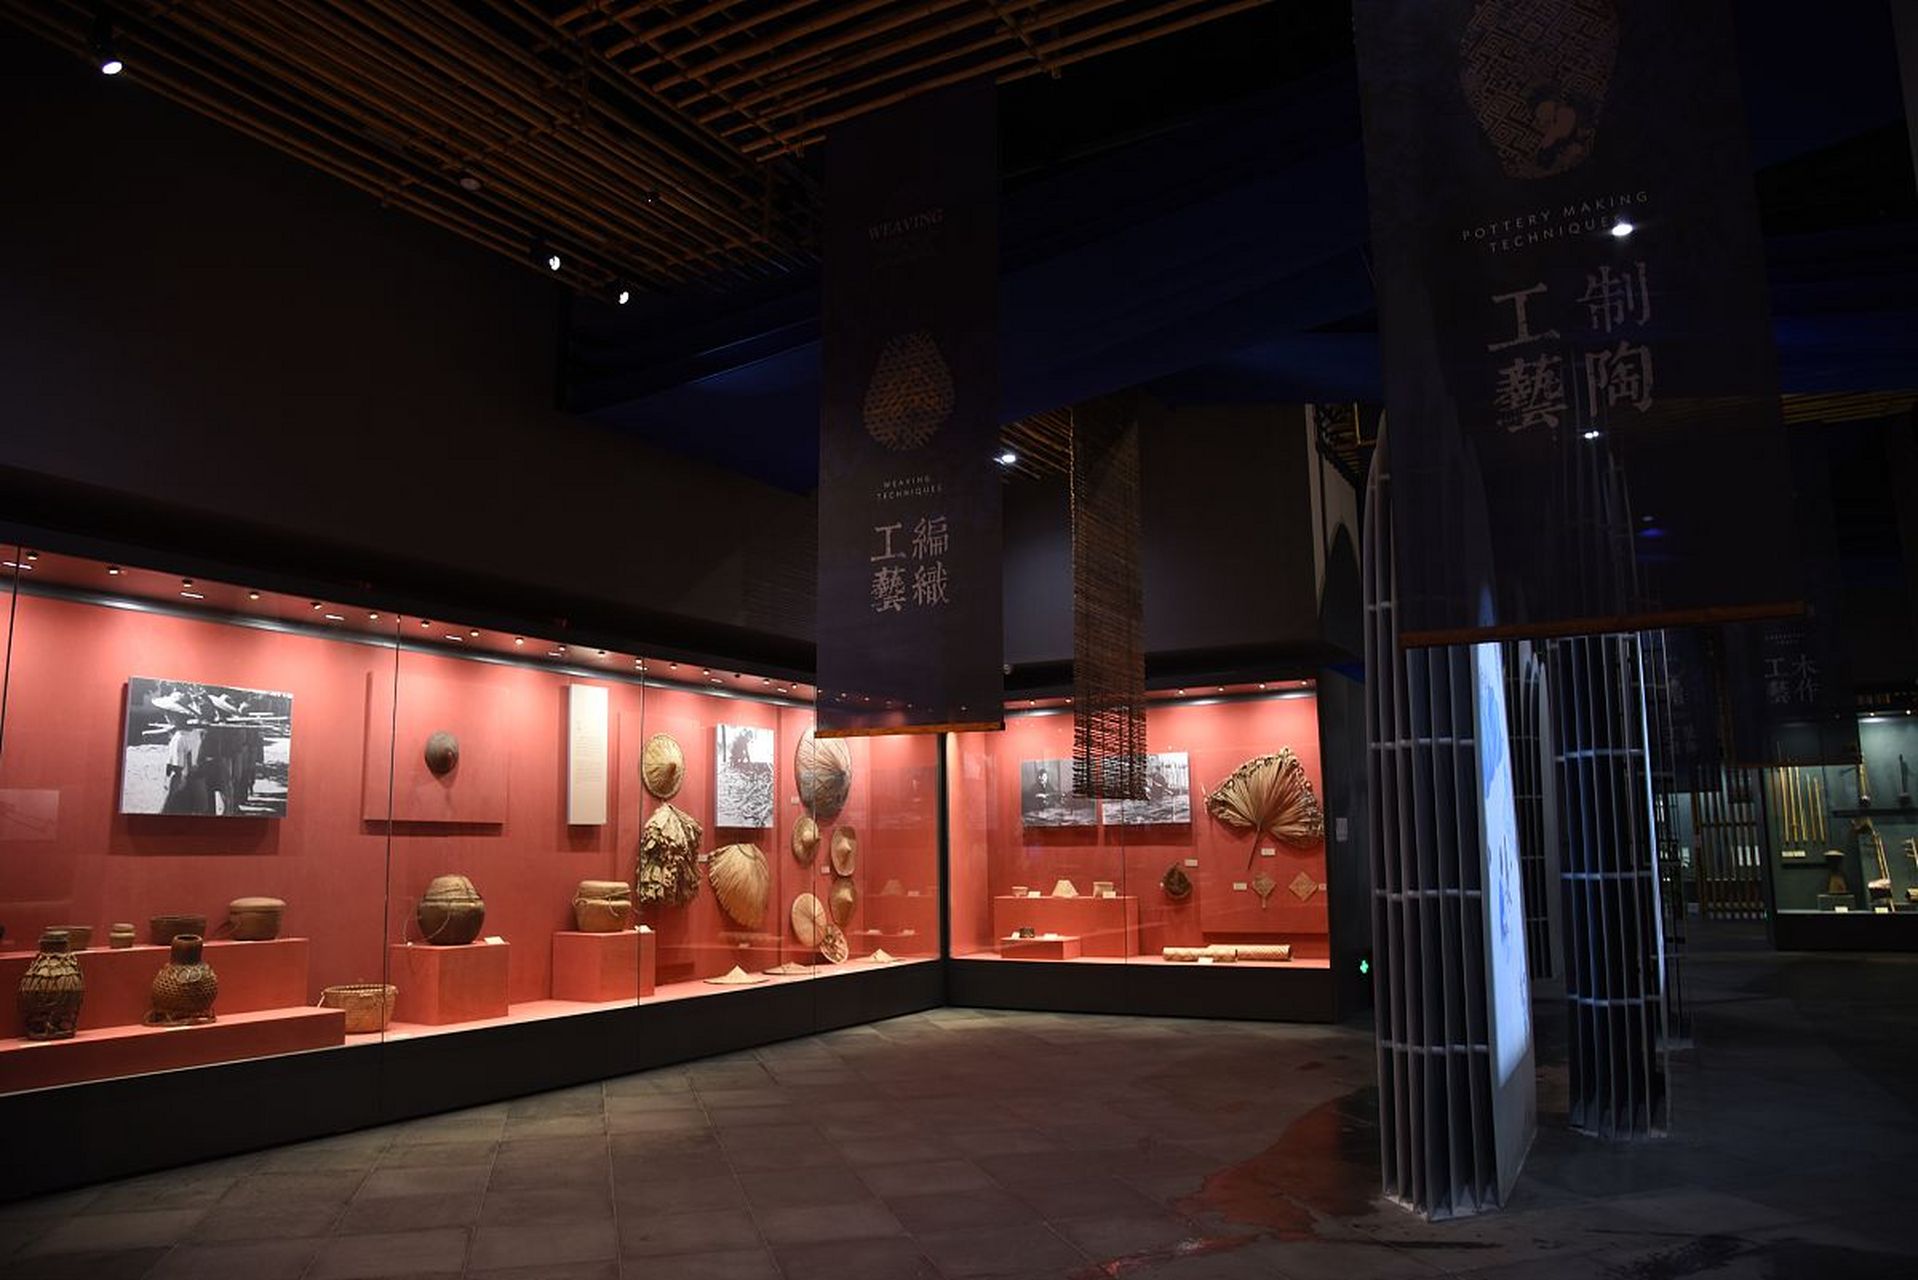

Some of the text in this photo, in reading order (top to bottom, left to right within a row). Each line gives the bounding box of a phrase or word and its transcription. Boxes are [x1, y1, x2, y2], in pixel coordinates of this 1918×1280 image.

[1461, 190, 1649, 241] POTTERY MAKING
[1489, 213, 1624, 254] TECHNIQUE
[1487, 281, 1569, 433] 工藝
[1576, 260, 1654, 418] 制陶
[870, 521, 907, 613] 工藝
[911, 515, 950, 607] 編織
